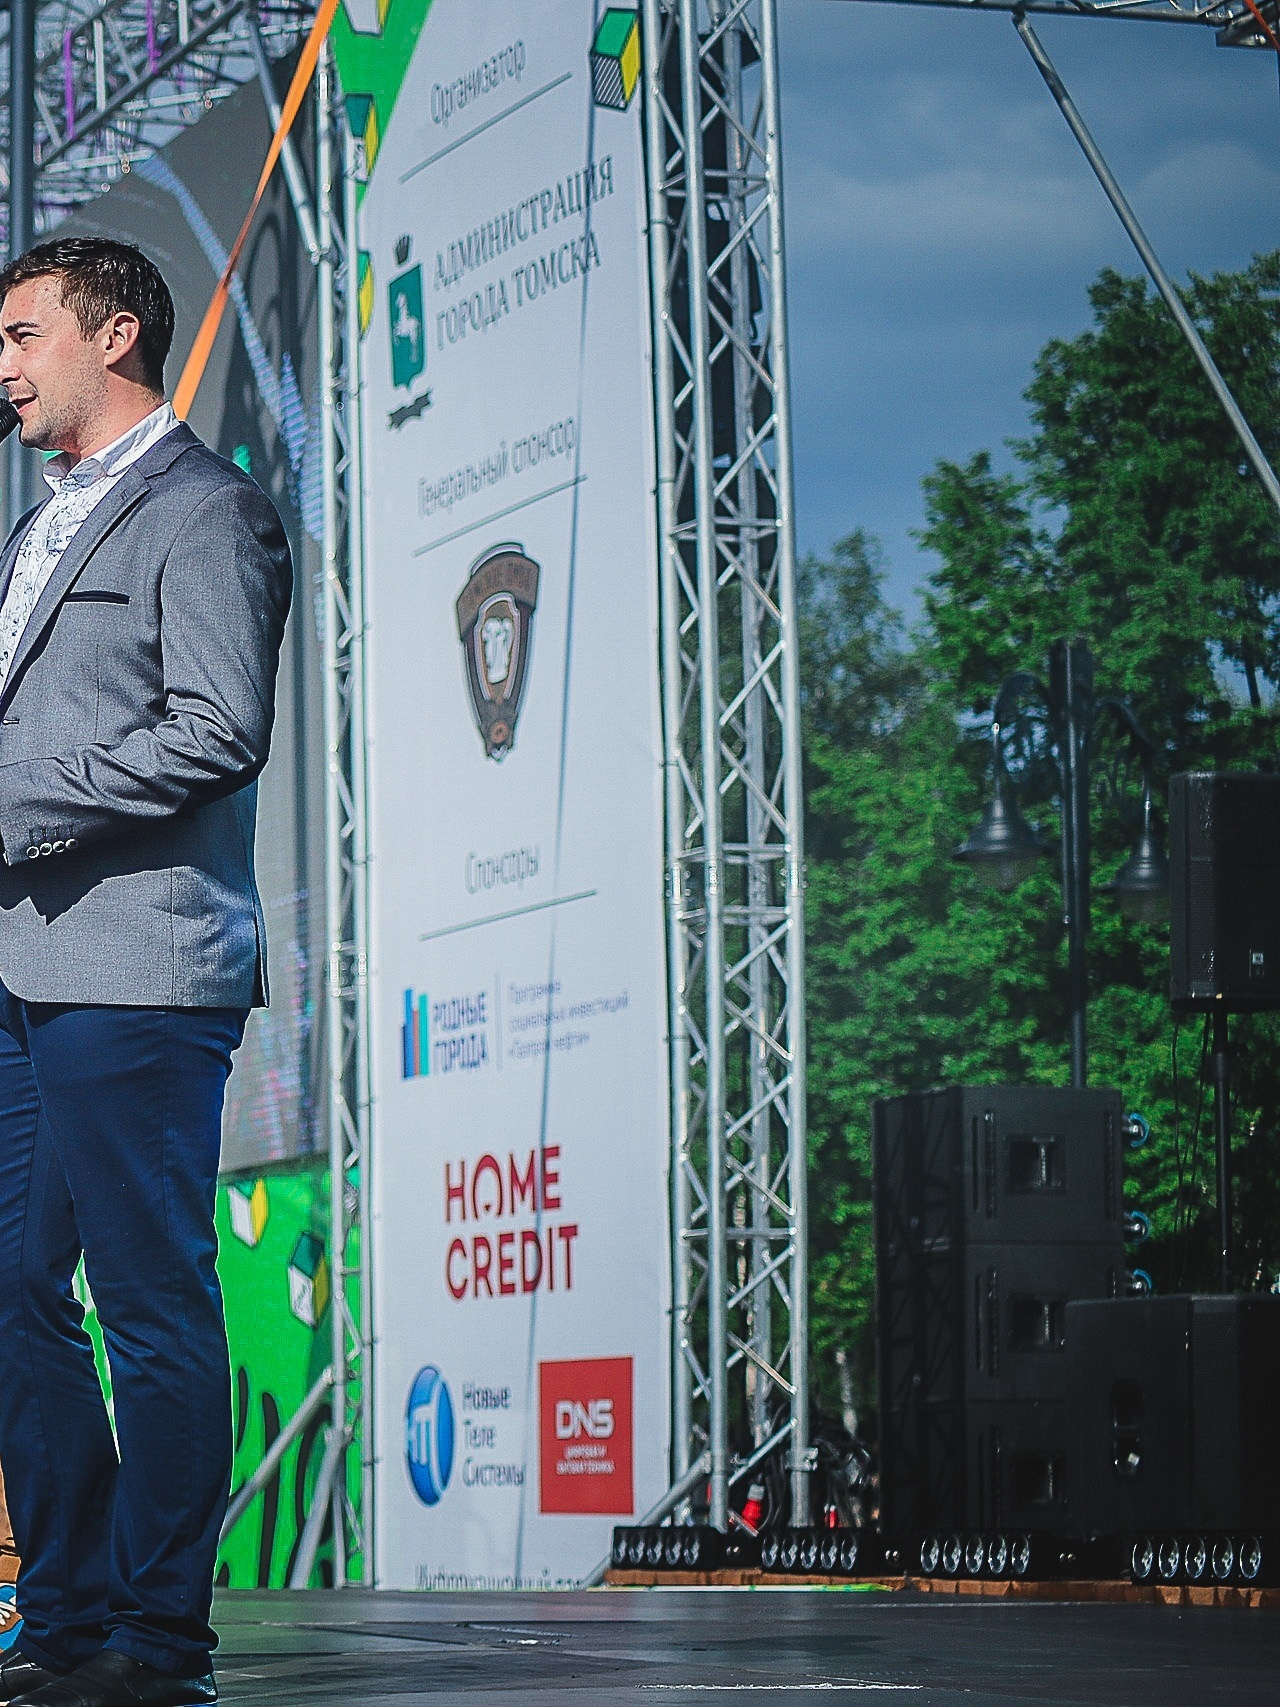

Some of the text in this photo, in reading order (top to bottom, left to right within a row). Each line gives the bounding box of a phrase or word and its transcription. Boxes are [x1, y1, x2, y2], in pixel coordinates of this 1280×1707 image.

[430, 38, 527, 129] Организатор
[433, 153, 615, 291] АДМИНИСТРАЦИЯ
[435, 229, 602, 352] ГОРОДА ТОМСКА
[445, 1145, 561, 1224] HOME
[447, 1224, 578, 1300] CREDIT
[462, 1381, 511, 1412] Новые
[463, 1418, 497, 1449] Теле
[555, 1398, 615, 1440] DNS
[462, 1455, 527, 1488] Системы
